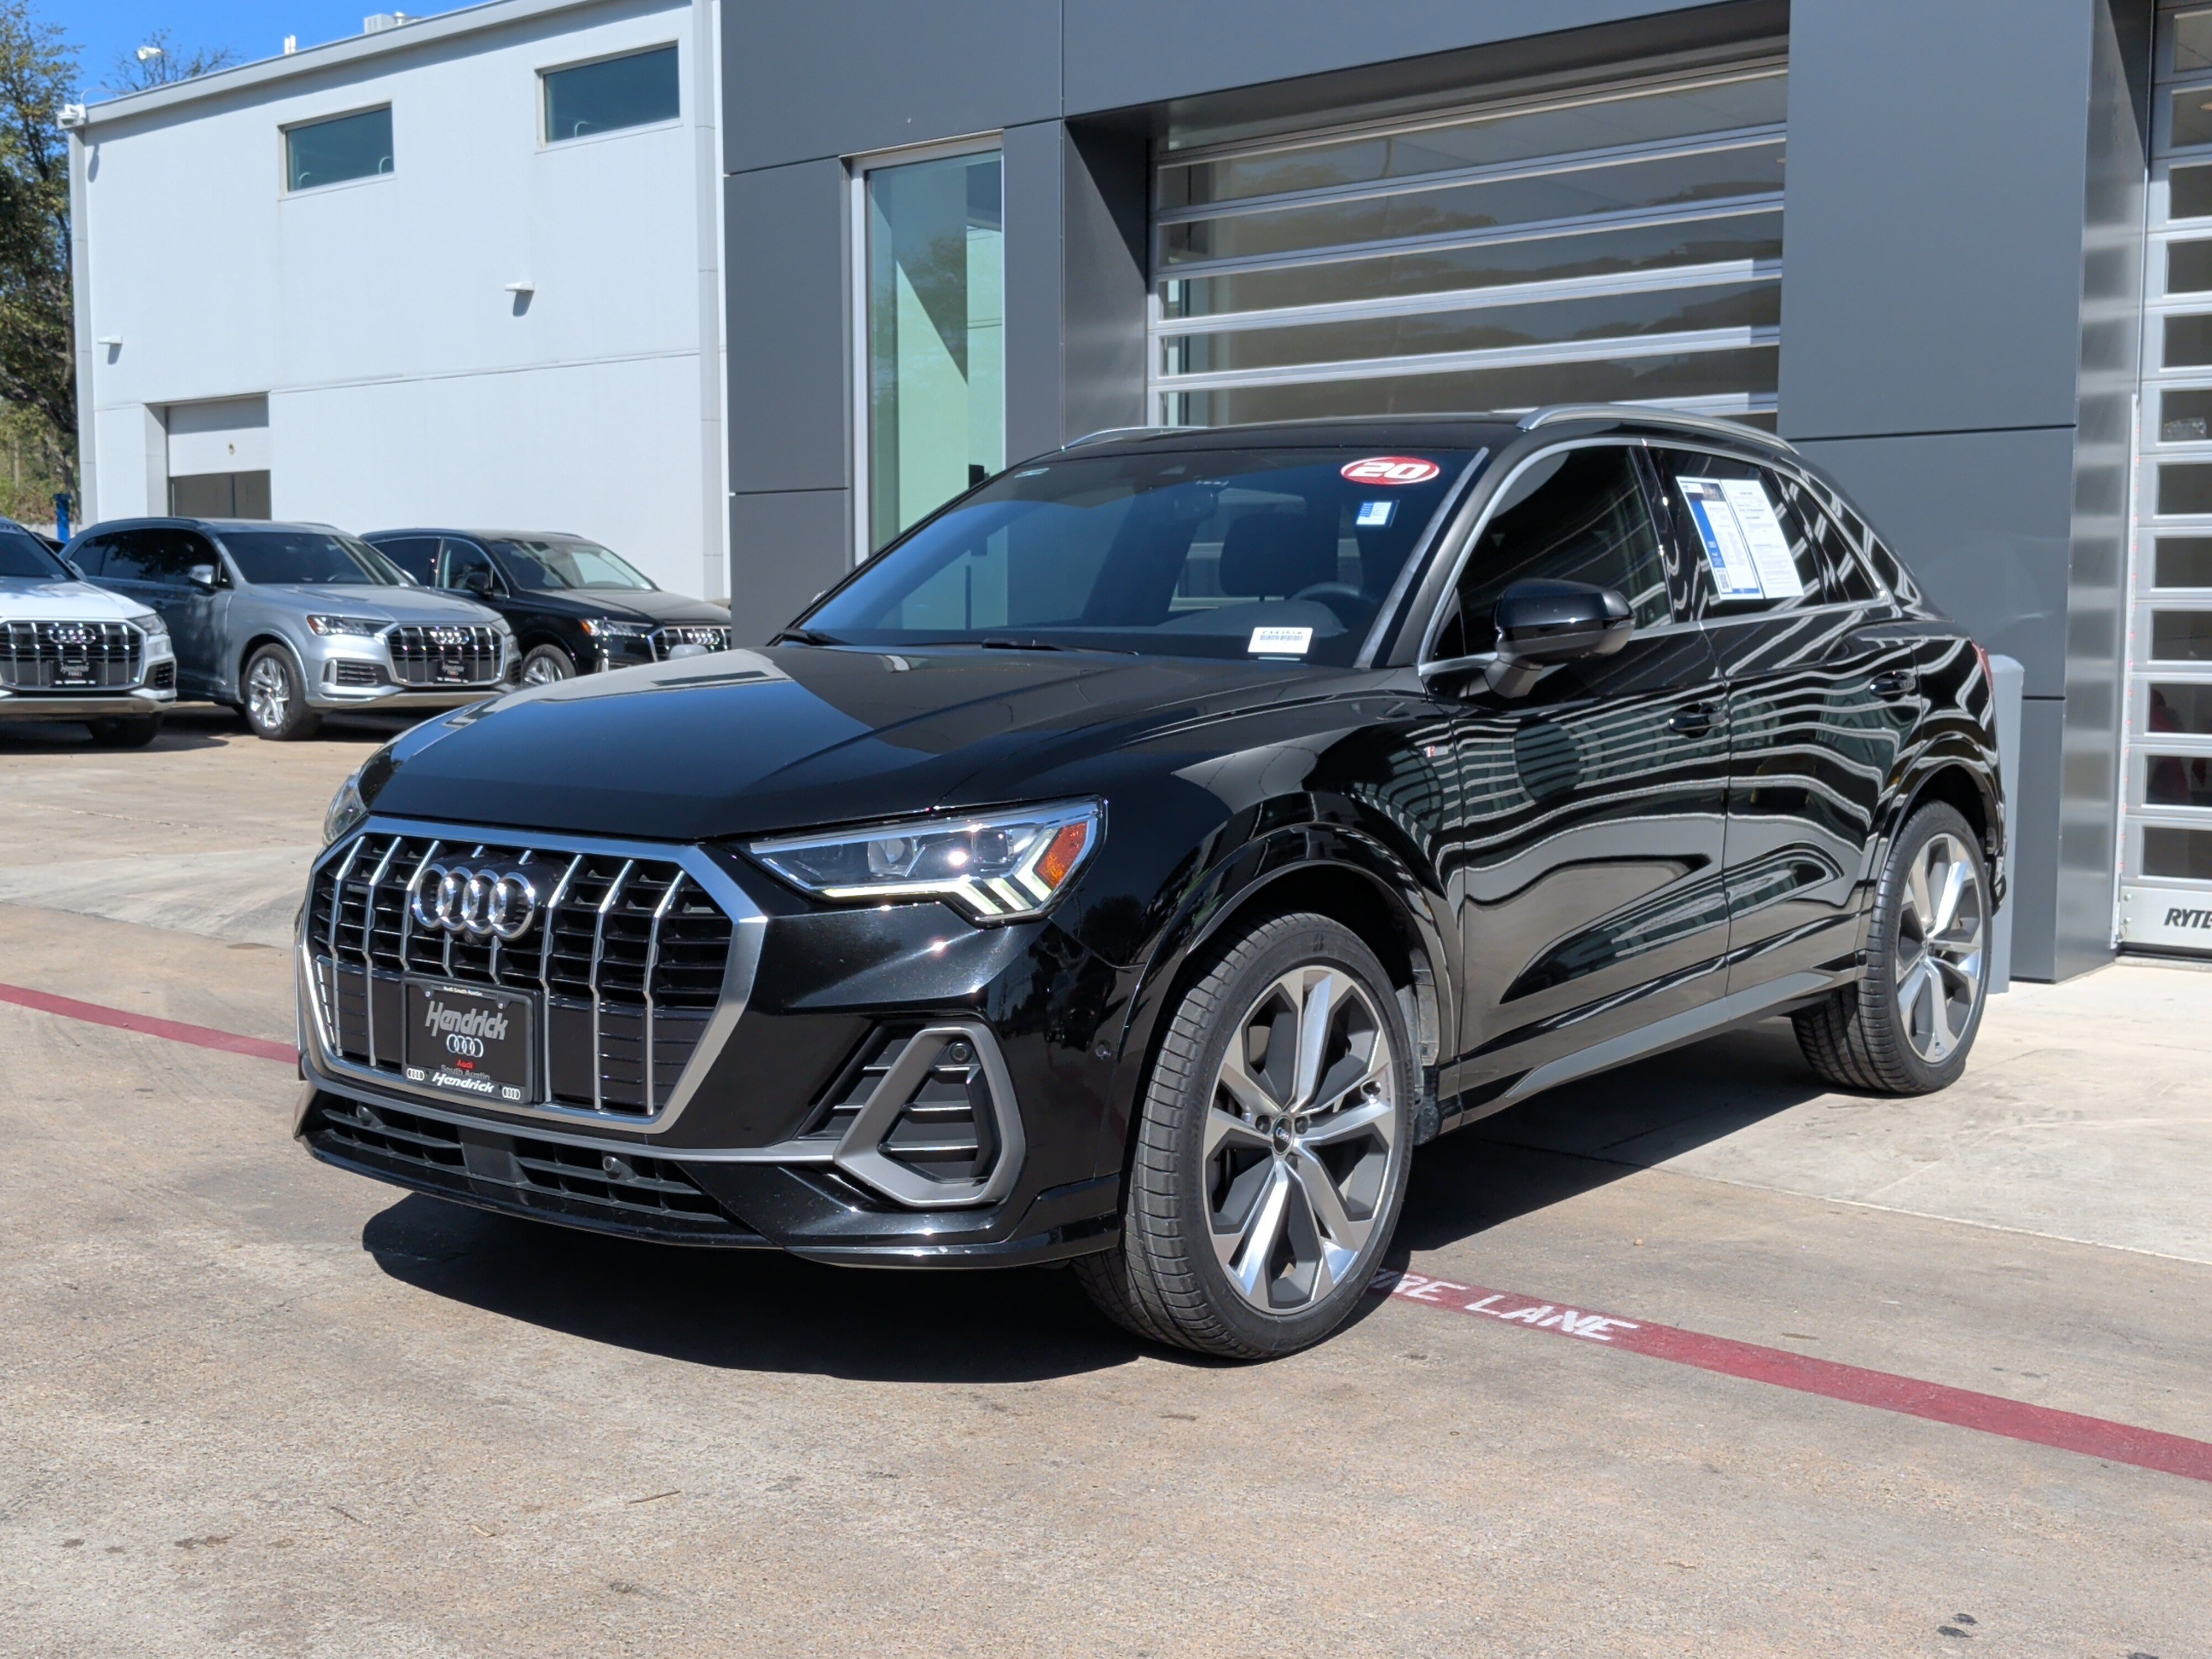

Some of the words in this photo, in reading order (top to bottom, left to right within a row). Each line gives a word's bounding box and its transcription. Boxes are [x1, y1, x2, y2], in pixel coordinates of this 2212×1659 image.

[1347, 462, 1431, 479] 20
[425, 1000, 508, 1040] Hendrick
[441, 1065, 463, 1076] South
[465, 1070, 491, 1081] Austin
[457, 1058, 473, 1069] Audi
[432, 1072, 495, 1093] Hendrick
[1464, 1295, 1639, 1340] LANE
